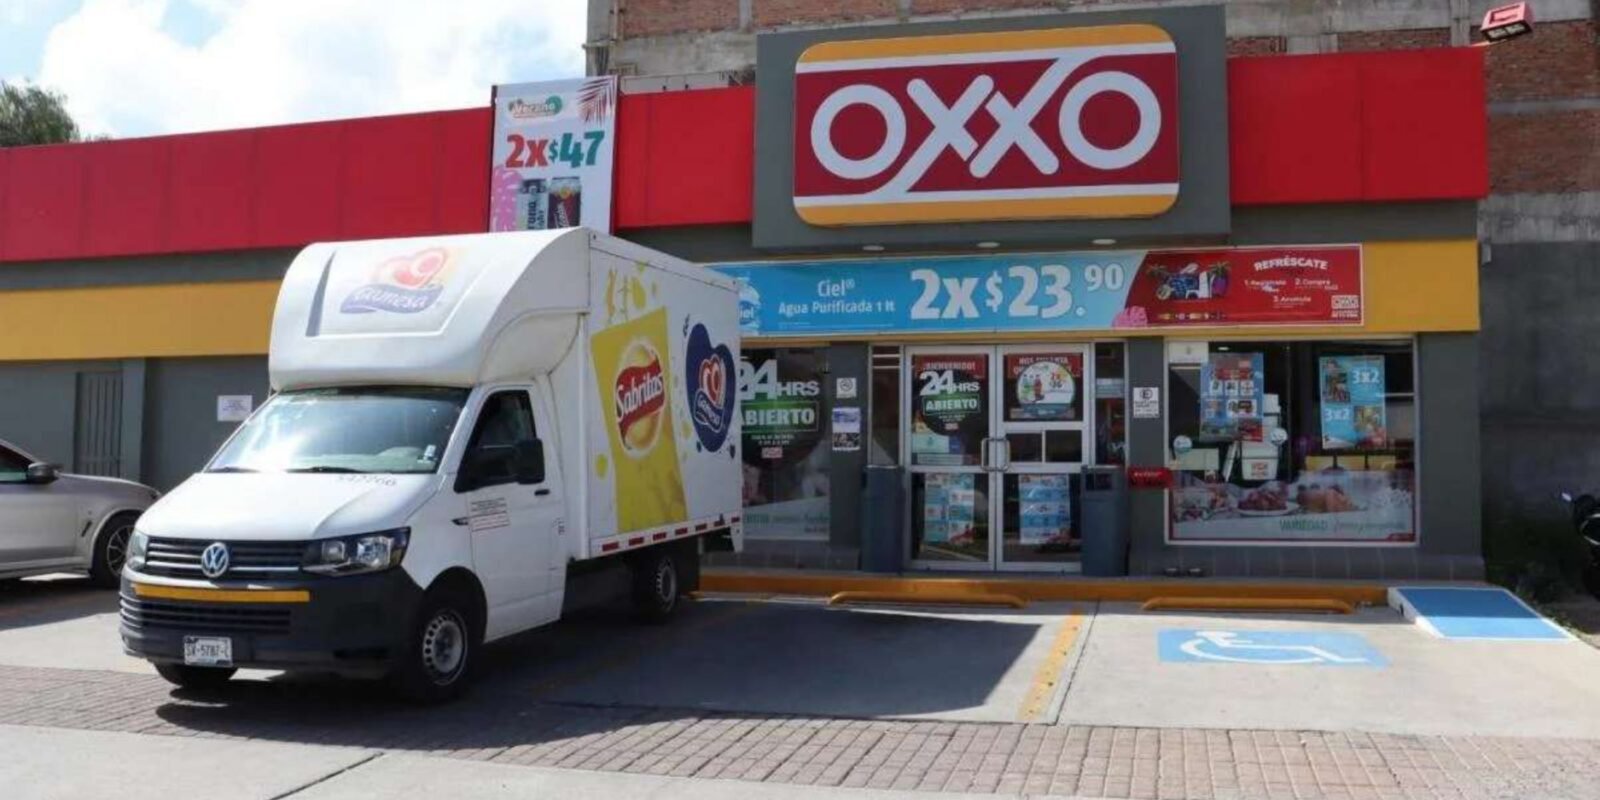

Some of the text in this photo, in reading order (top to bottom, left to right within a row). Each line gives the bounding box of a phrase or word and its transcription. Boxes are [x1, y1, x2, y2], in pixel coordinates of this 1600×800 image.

[811, 60, 1161, 193] OXXO
[1253, 255, 1328, 271] REFRÉSCATE
[778, 301, 808, 318] Agua
[812, 299, 873, 314] Purificada
[617, 372, 664, 421] Sabritas
[926, 399, 977, 411] ABIERTO
